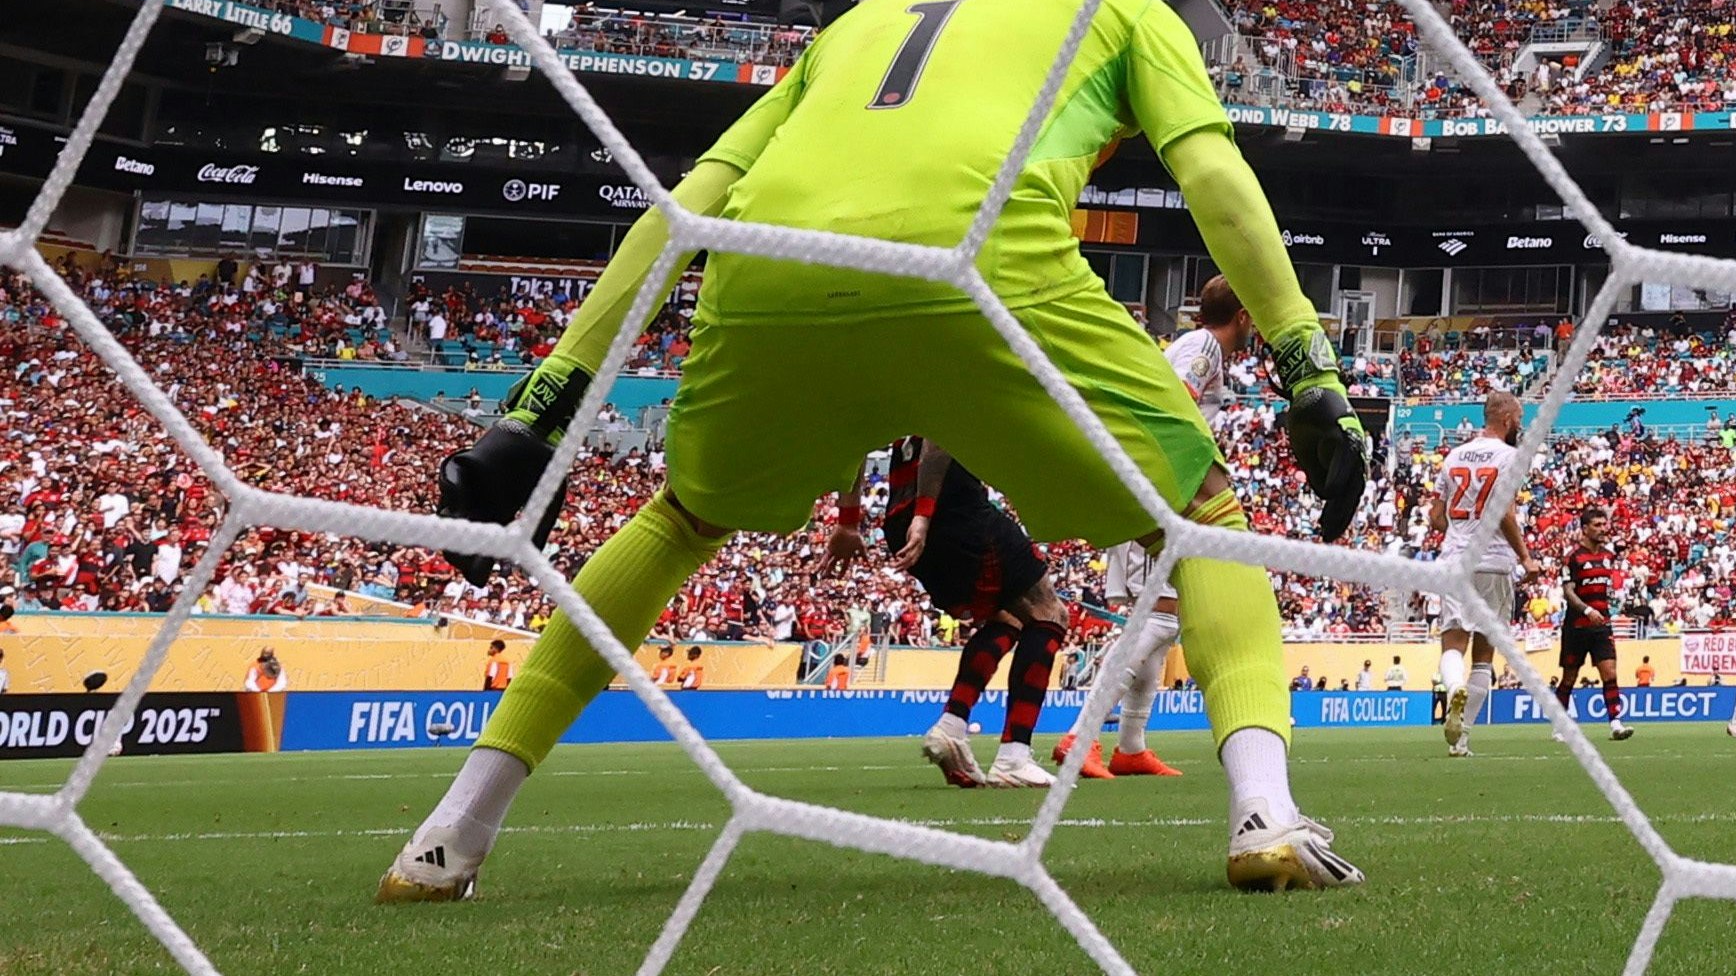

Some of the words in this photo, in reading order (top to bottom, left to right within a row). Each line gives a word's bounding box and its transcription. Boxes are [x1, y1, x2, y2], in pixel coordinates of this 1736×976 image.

[225, 0, 270, 30] LITTLE
[270, 12, 293, 35] 66
[441, 39, 533, 68] DWIGHT
[562, 51, 681, 80] TEPHENSON
[687, 61, 720, 81] 57
[1270, 108, 1319, 129] WEBB
[1327, 113, 1351, 131] 78
[1442, 119, 1478, 137] BOB
[1601, 115, 1627, 132] 73
[114, 156, 155, 176] Betano
[302, 172, 364, 187] Hisense
[404, 177, 463, 194] Lenovo
[528, 183, 560, 200] PIF
[1293, 233, 1325, 246] airbnb
[1361, 236, 1391, 246] ULTRA
[1507, 236, 1552, 249] Betano
[1660, 232, 1706, 245] Hisense
[1458, 450, 1494, 463] LAIMER
[1448, 467, 1499, 520] 27
[1703, 639, 1725, 652] RED
[1158, 690, 1204, 714] TICKET
[1322, 698, 1350, 722] FIFA
[1352, 697, 1408, 722] COLLECT
[1588, 692, 1717, 717] COLLECT
[348, 701, 416, 742] FIFA
